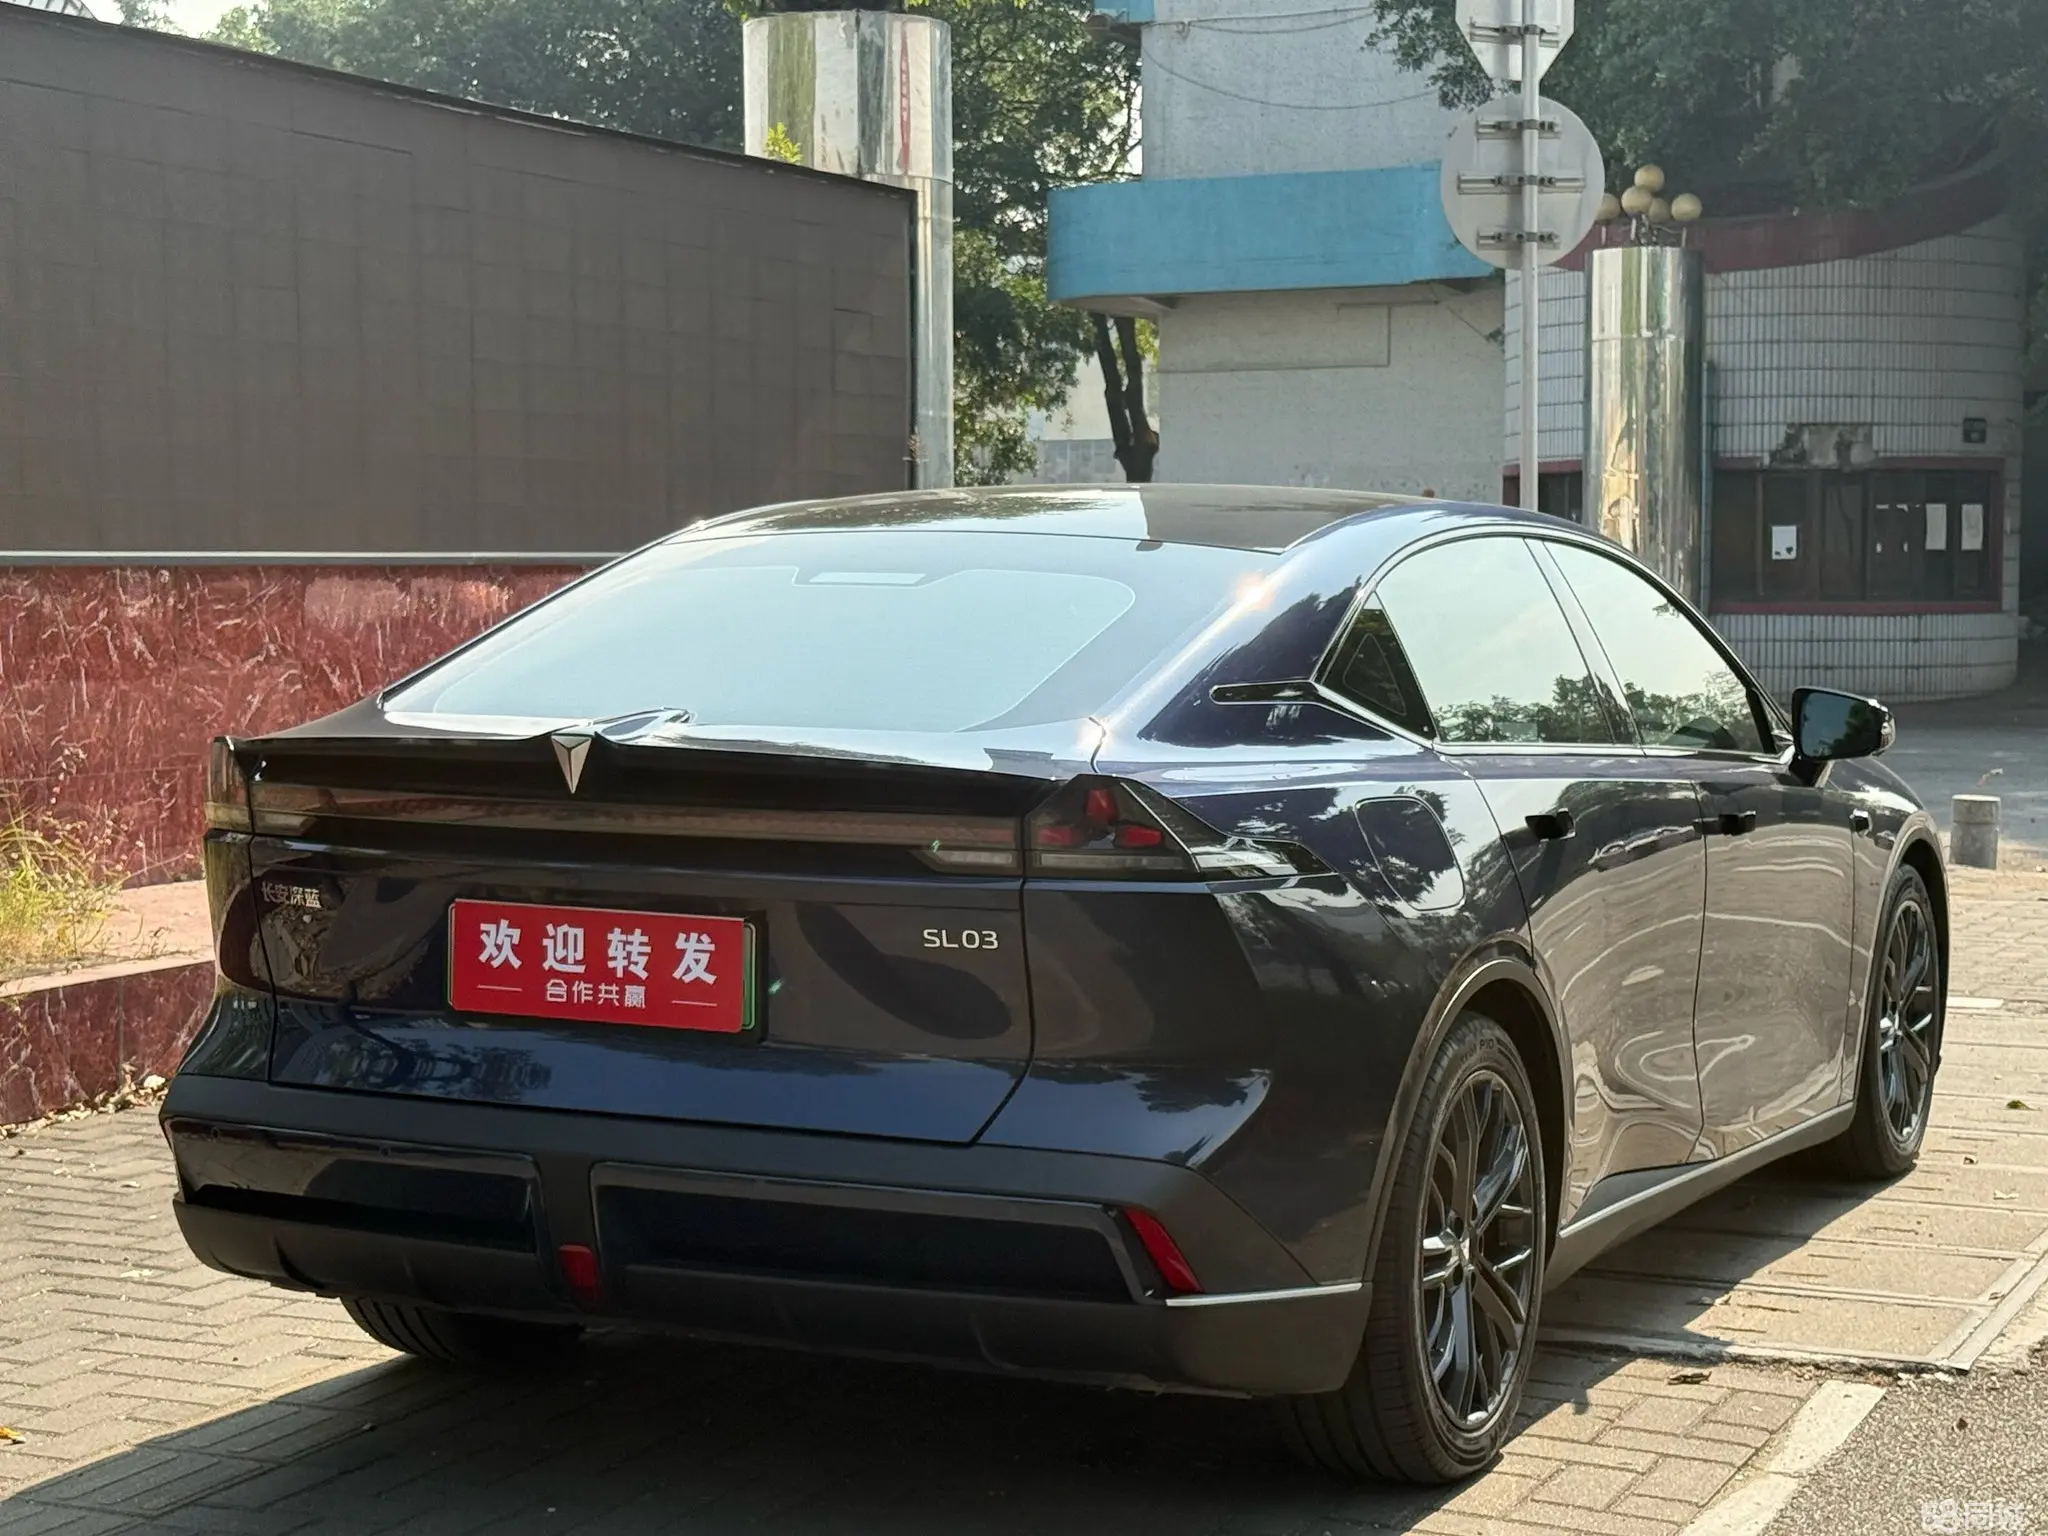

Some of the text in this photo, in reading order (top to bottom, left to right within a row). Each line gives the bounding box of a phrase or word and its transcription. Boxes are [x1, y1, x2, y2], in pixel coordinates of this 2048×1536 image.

[261, 881, 321, 908] 长安深蓝
[478, 919, 718, 985] 欢迎转发
[923, 929, 999, 949] SL03
[545, 979, 647, 1009] 合作共赢
